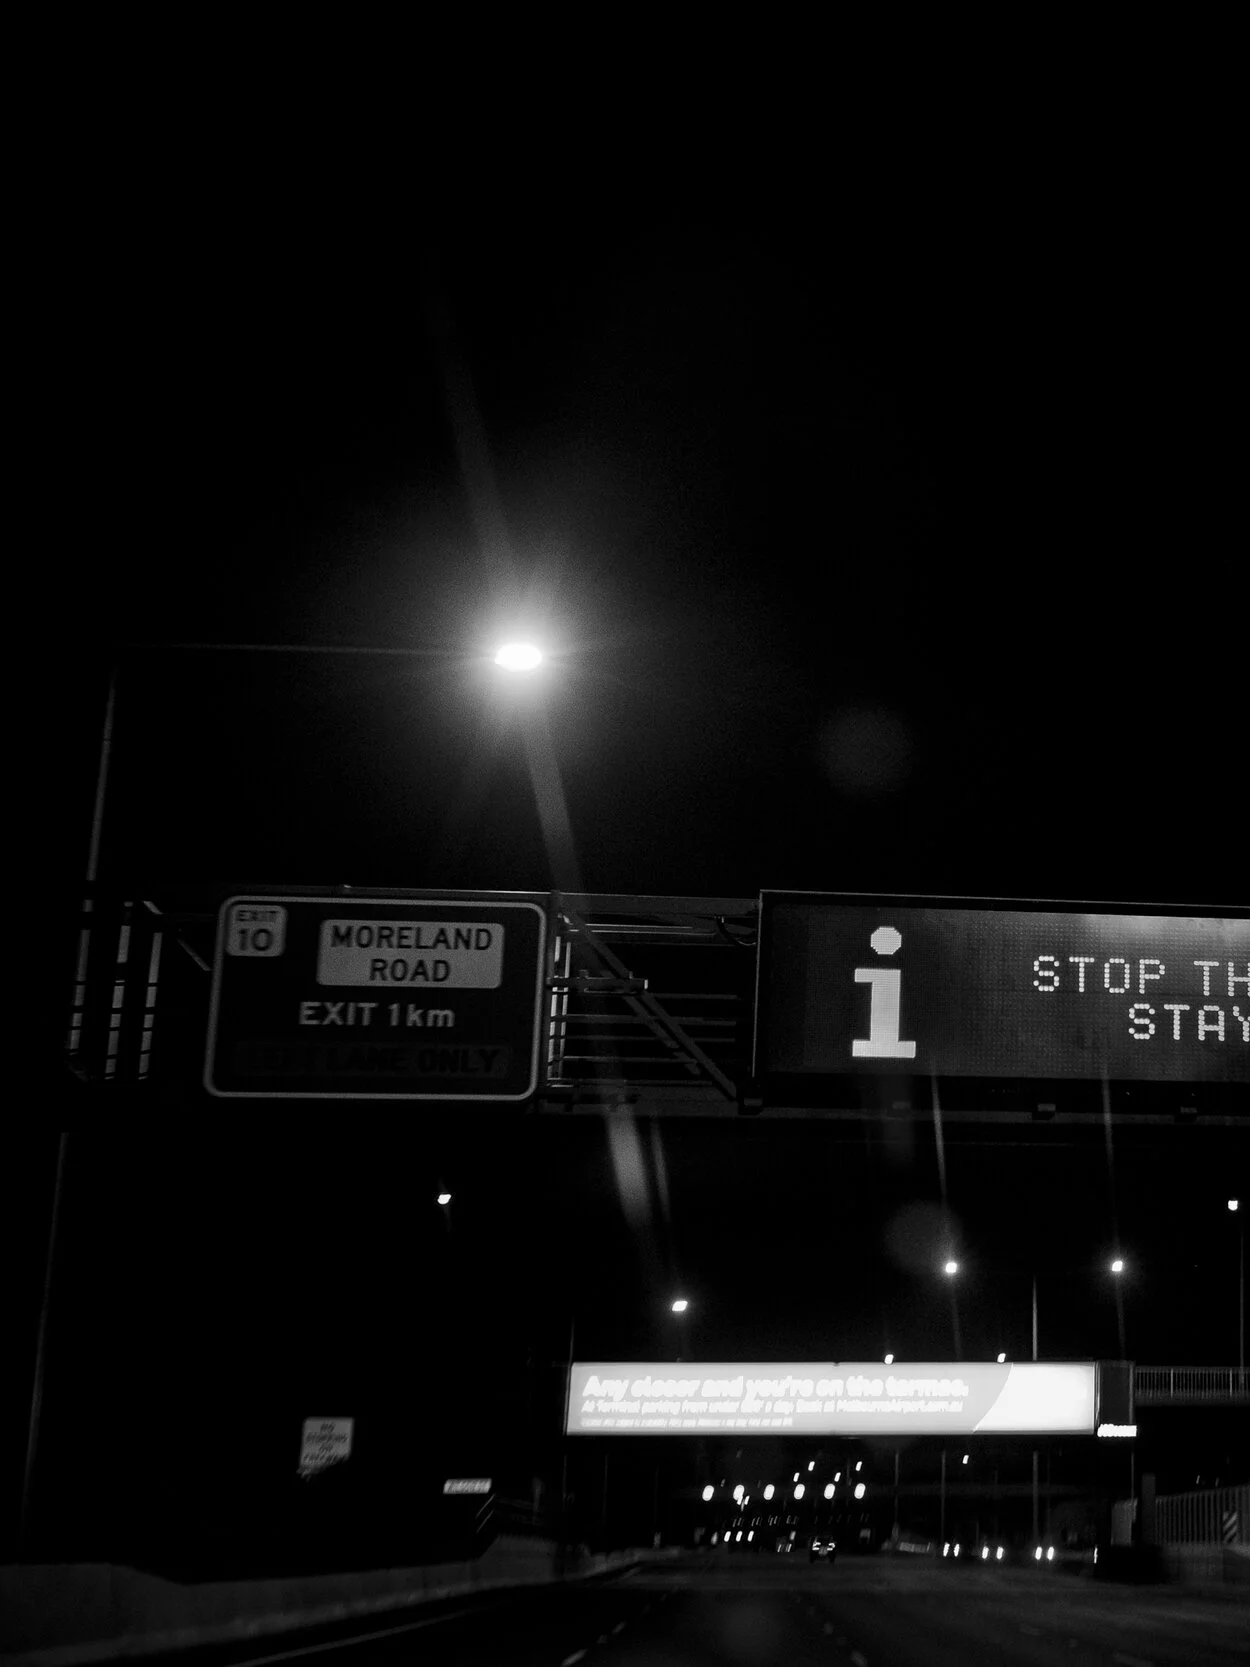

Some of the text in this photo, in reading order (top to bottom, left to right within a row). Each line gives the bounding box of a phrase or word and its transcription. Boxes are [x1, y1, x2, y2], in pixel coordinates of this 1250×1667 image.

[236, 909, 280, 922] EXIT
[238, 928, 274, 951] 10
[330, 925, 493, 951] MORELAND
[369, 958, 451, 983] ROAD
[1033, 955, 1165, 994] STOP
[299, 1001, 380, 1027] EXIT
[416, 1047, 500, 1074] ONLY
